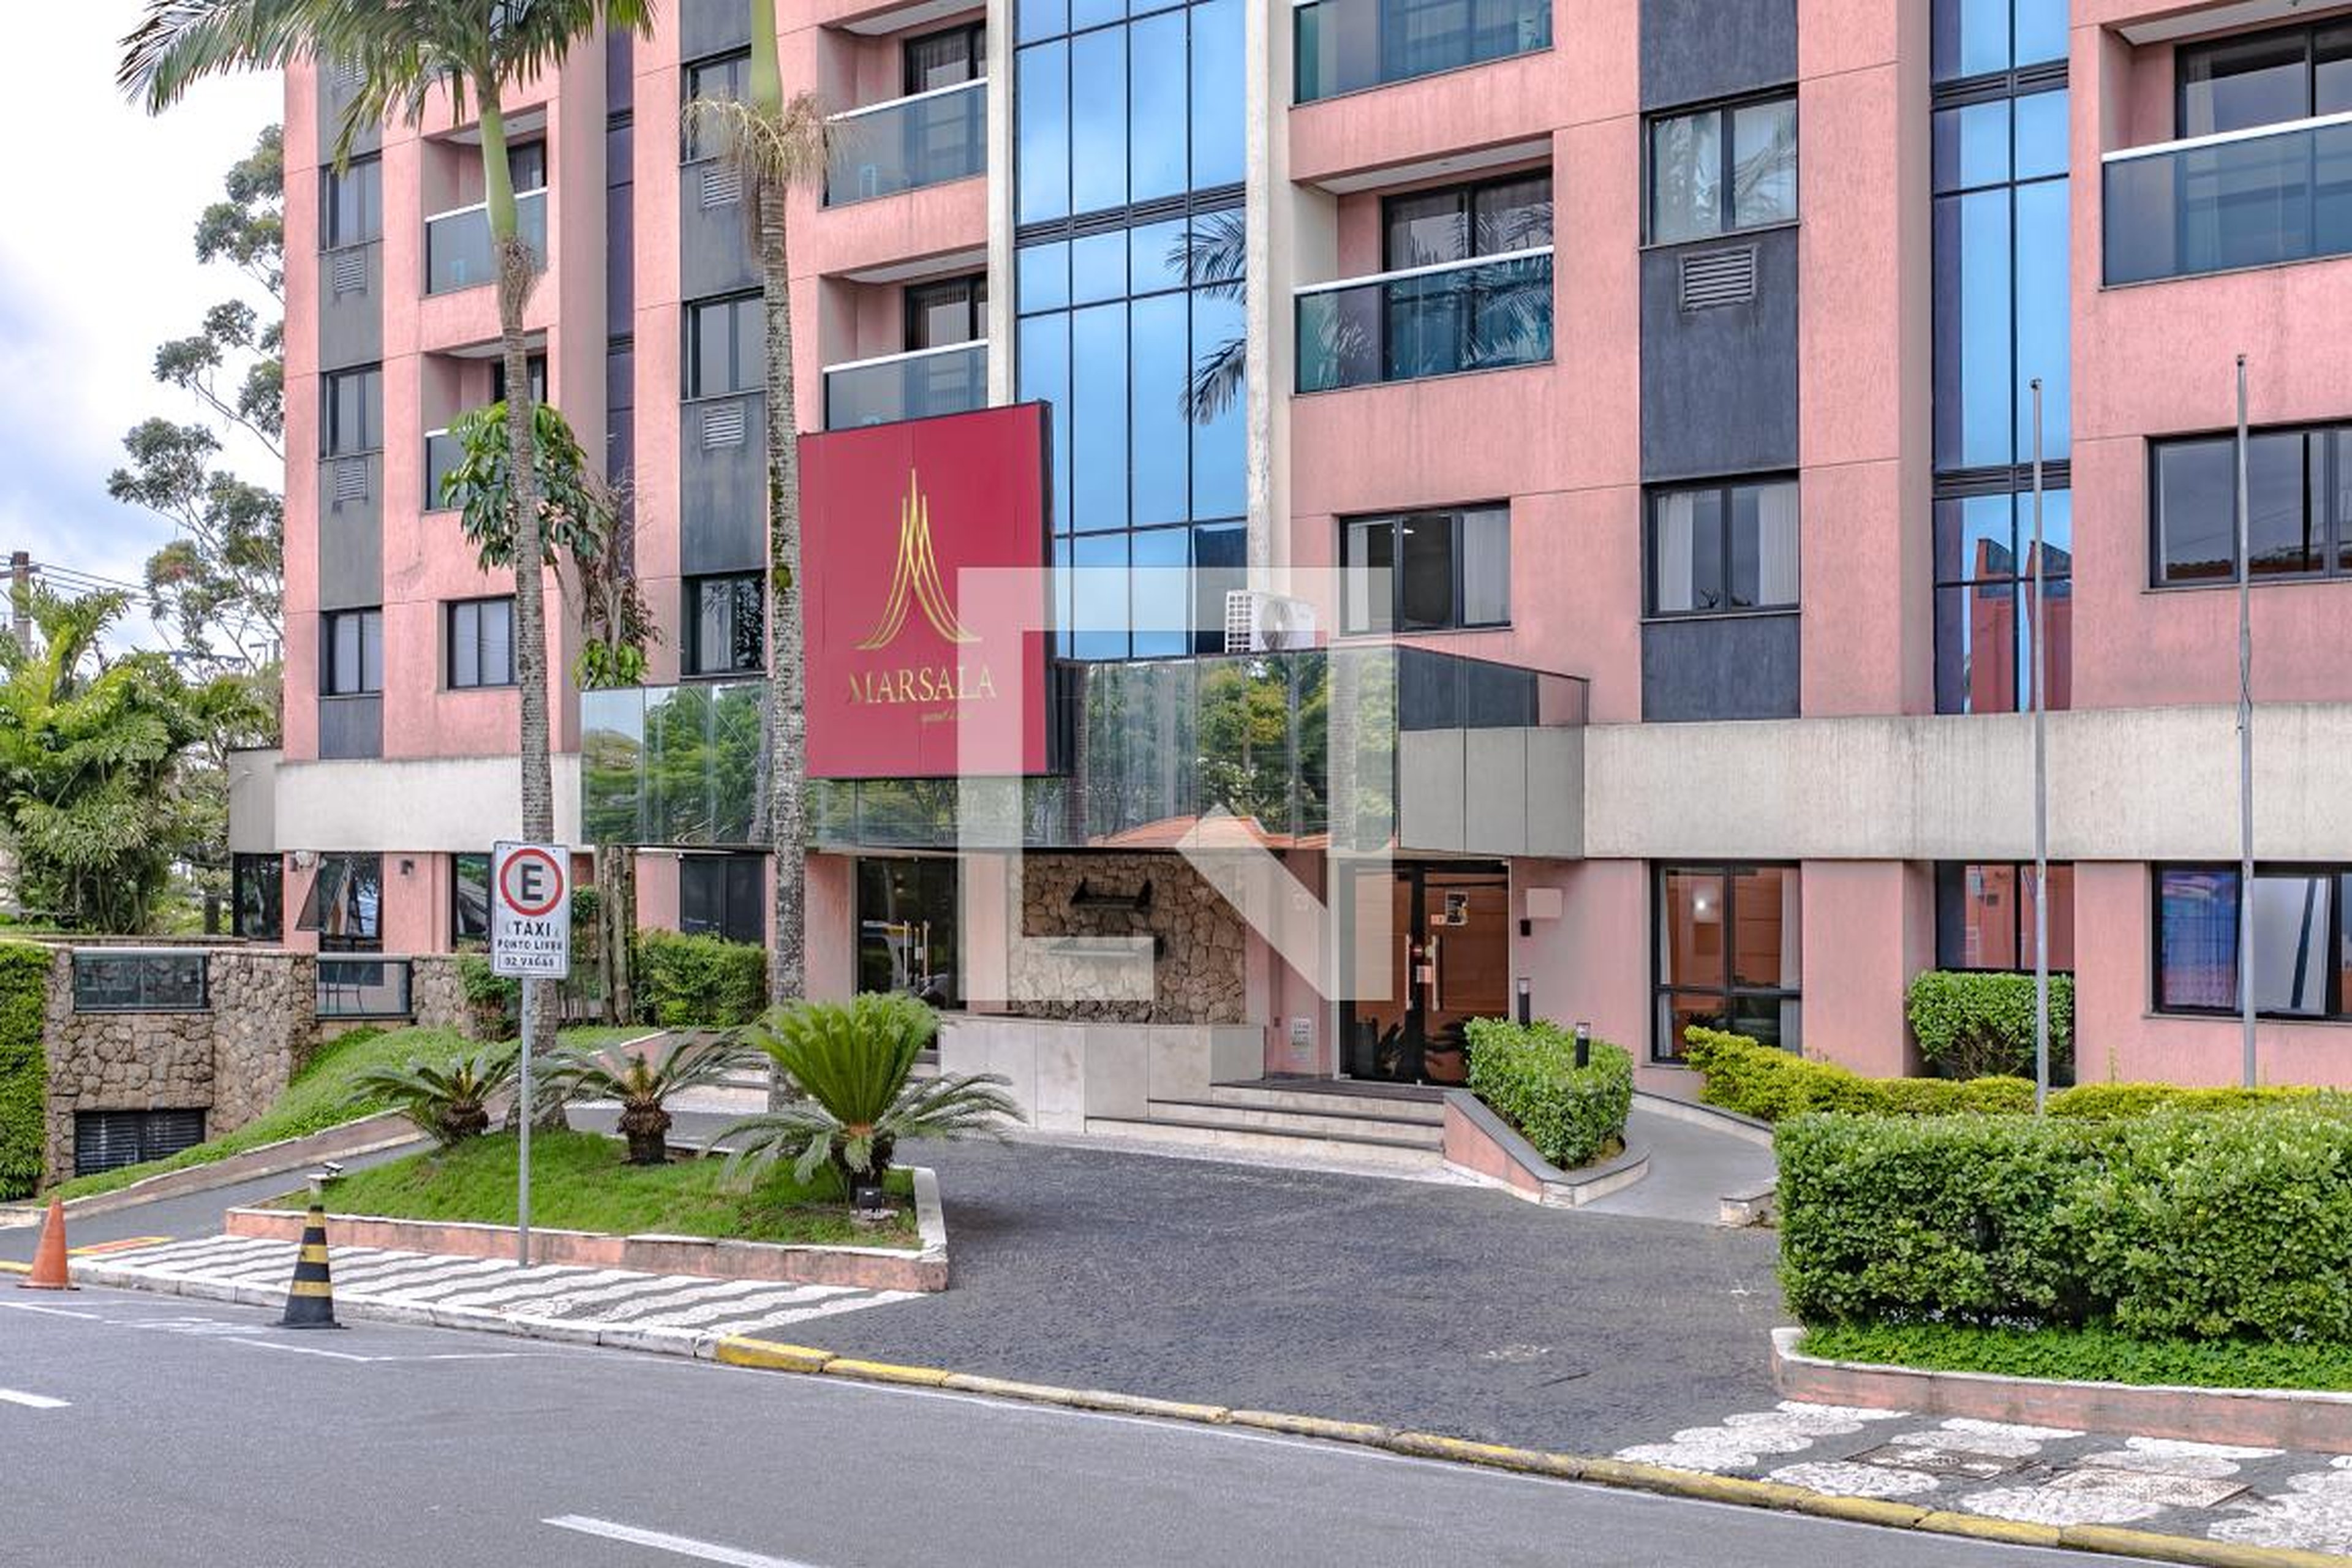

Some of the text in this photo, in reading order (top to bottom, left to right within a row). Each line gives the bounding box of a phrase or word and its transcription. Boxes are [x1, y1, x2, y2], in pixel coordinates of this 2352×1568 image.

[849, 665, 997, 703] MARSALA
[522, 864, 543, 900] E
[513, 921, 550, 937] TAXI
[497, 939, 531, 950] PONTO
